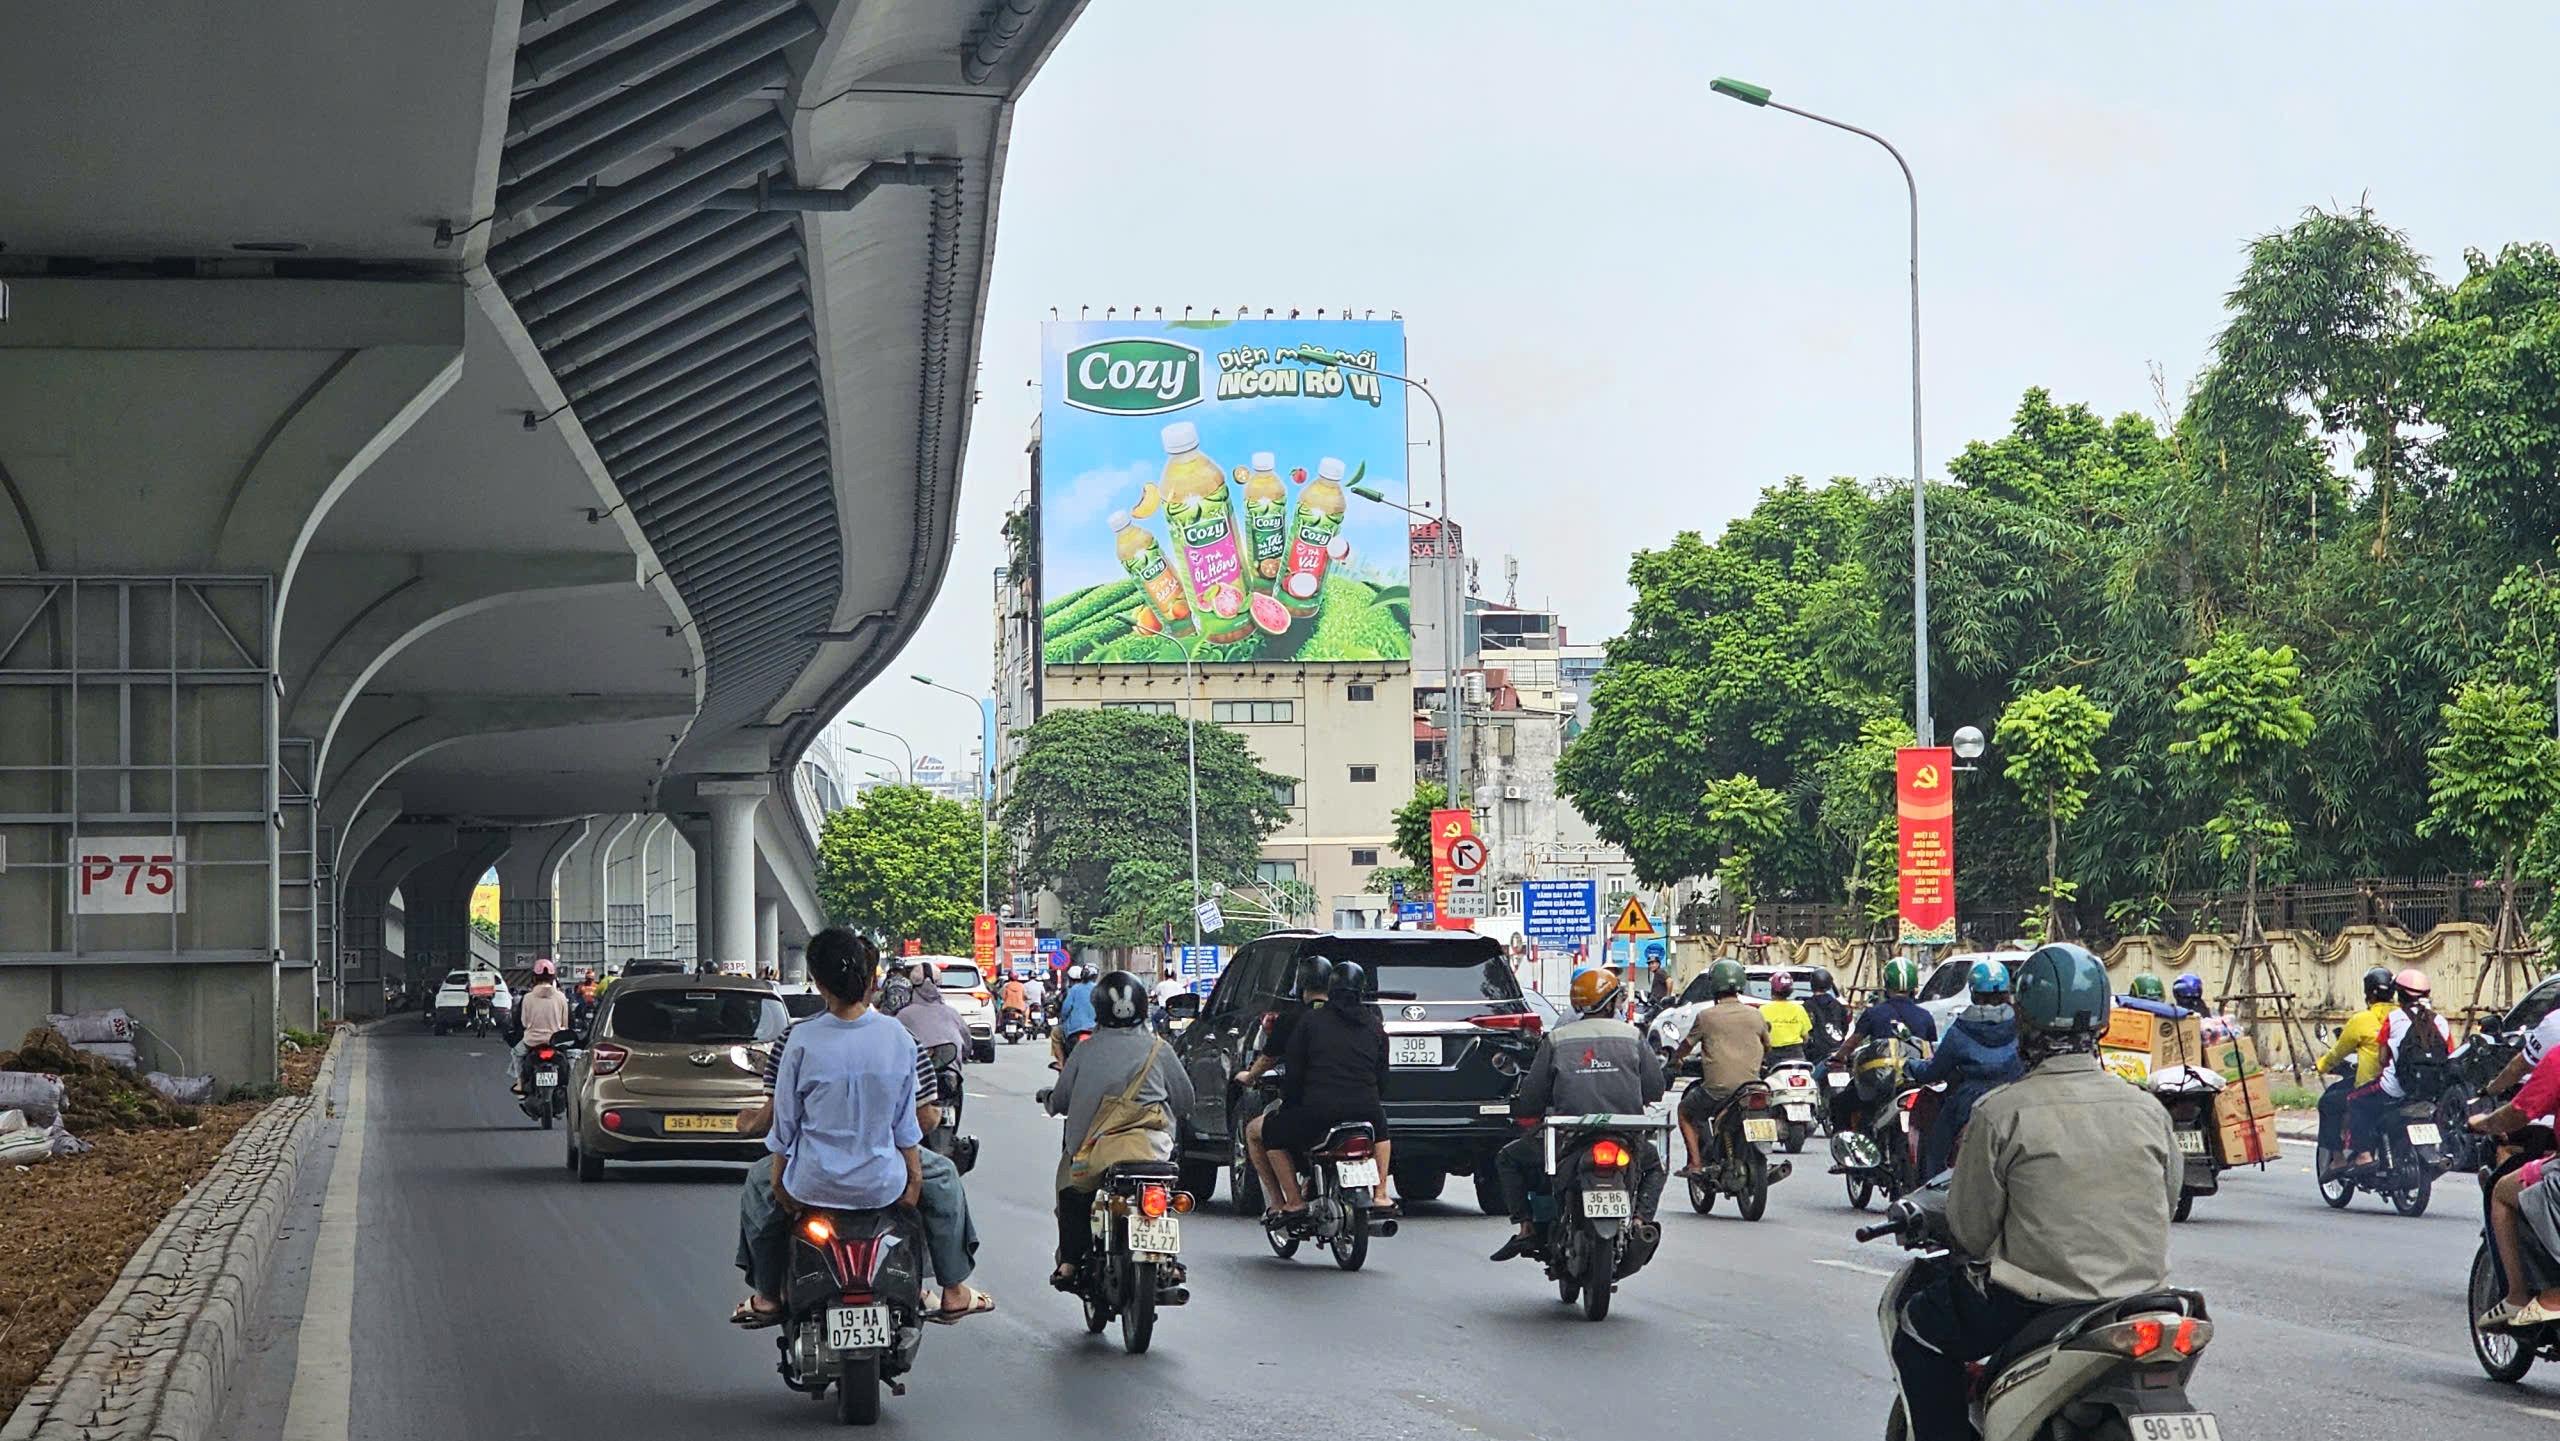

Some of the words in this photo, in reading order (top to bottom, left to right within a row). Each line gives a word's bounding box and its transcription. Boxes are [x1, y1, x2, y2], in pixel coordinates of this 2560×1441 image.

[1219, 345, 1268, 367] Diện
[1079, 352, 1187, 400] Cozy
[1217, 369, 1299, 398] NGON
[1305, 366, 1342, 394] RÕ
[1350, 374, 1380, 404] VỊ
[1256, 517, 1280, 527] Cozy
[1187, 522, 1225, 542] Cozy
[1302, 528, 1328, 544] Cozy
[1143, 558, 1166, 579] Cozy
[82, 856, 173, 894] P75
[1403, 1039, 1426, 1050] 30B
[1395, 1052, 1436, 1063] 152.32
[1590, 1193, 1622, 1203] 36-B6
[1588, 1204, 1627, 1215] 976.96
[1132, 1233, 1175, 1250] 354.27
[839, 1309, 879, 1328] 19-AA
[833, 1328, 885, 1347] 075.34
[2144, 1417, 2208, 1440] 98-B1
